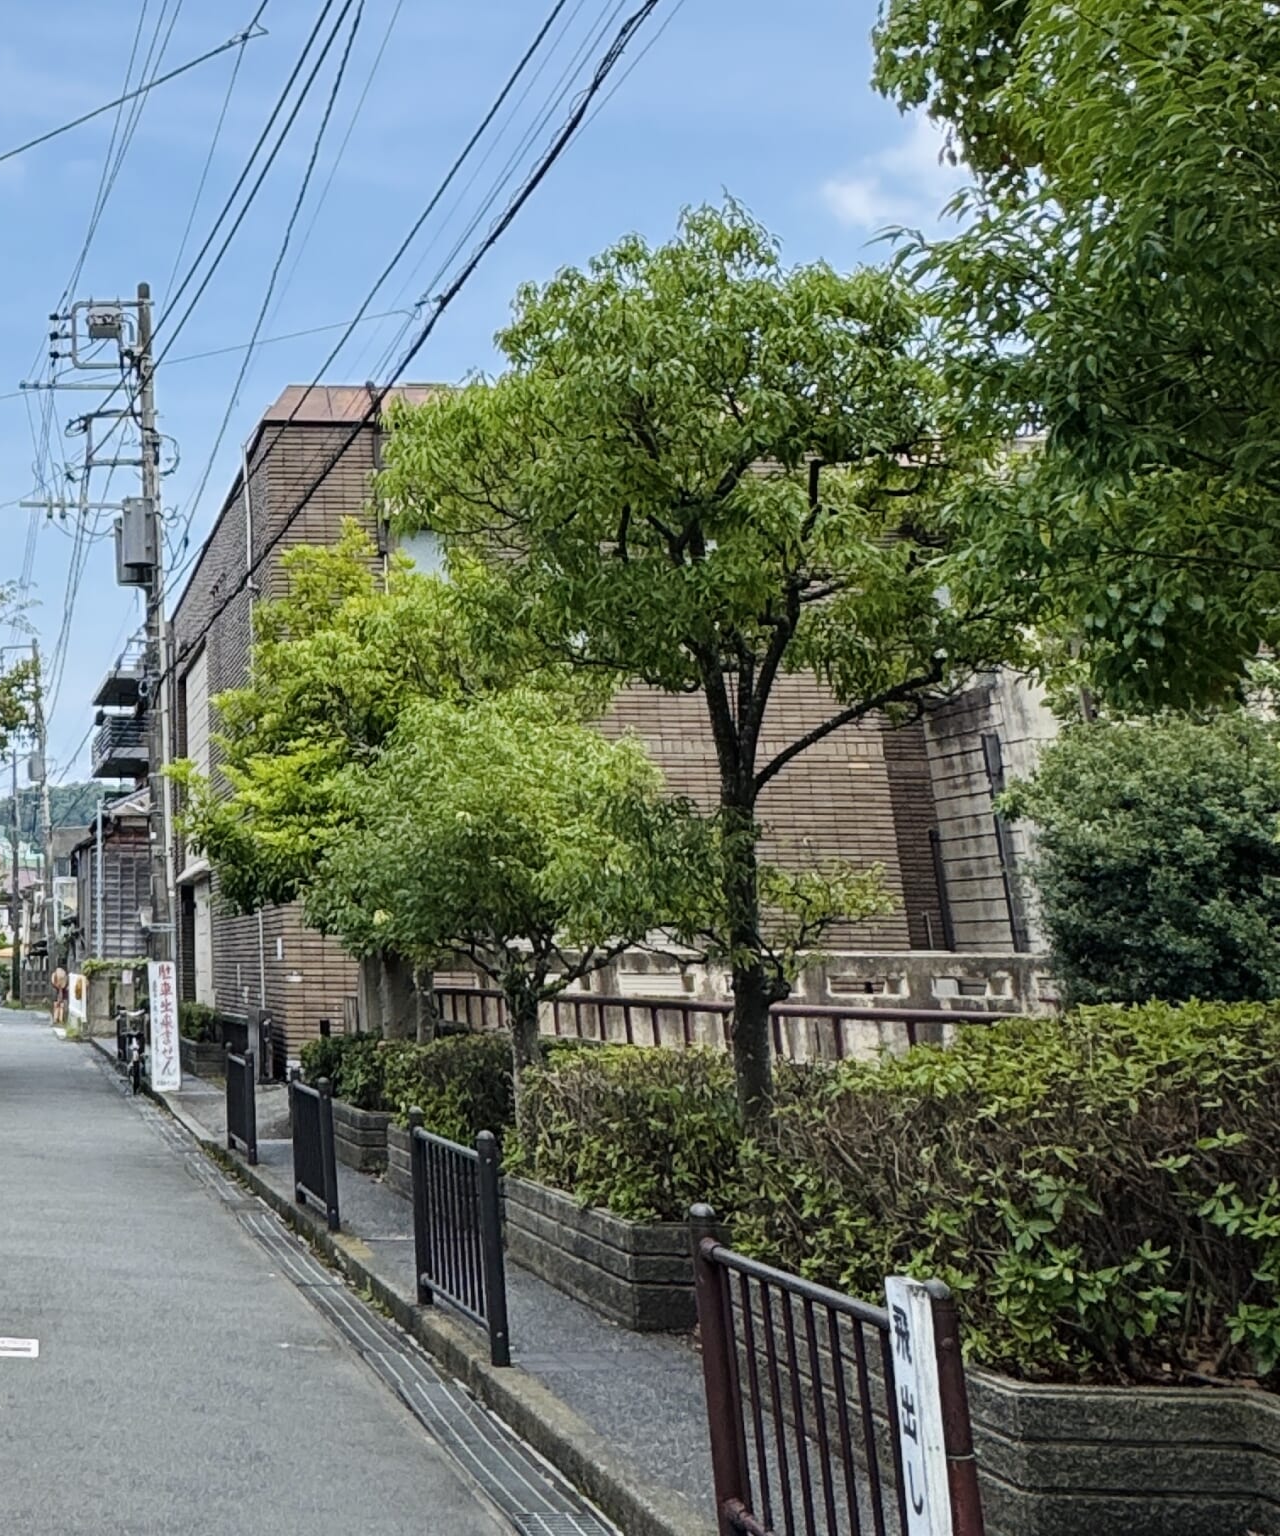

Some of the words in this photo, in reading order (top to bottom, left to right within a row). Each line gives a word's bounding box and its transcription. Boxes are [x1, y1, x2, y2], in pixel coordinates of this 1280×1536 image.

[158, 964, 177, 1076] 駐車出来ません
[892, 1304, 923, 1516] 飛出し
